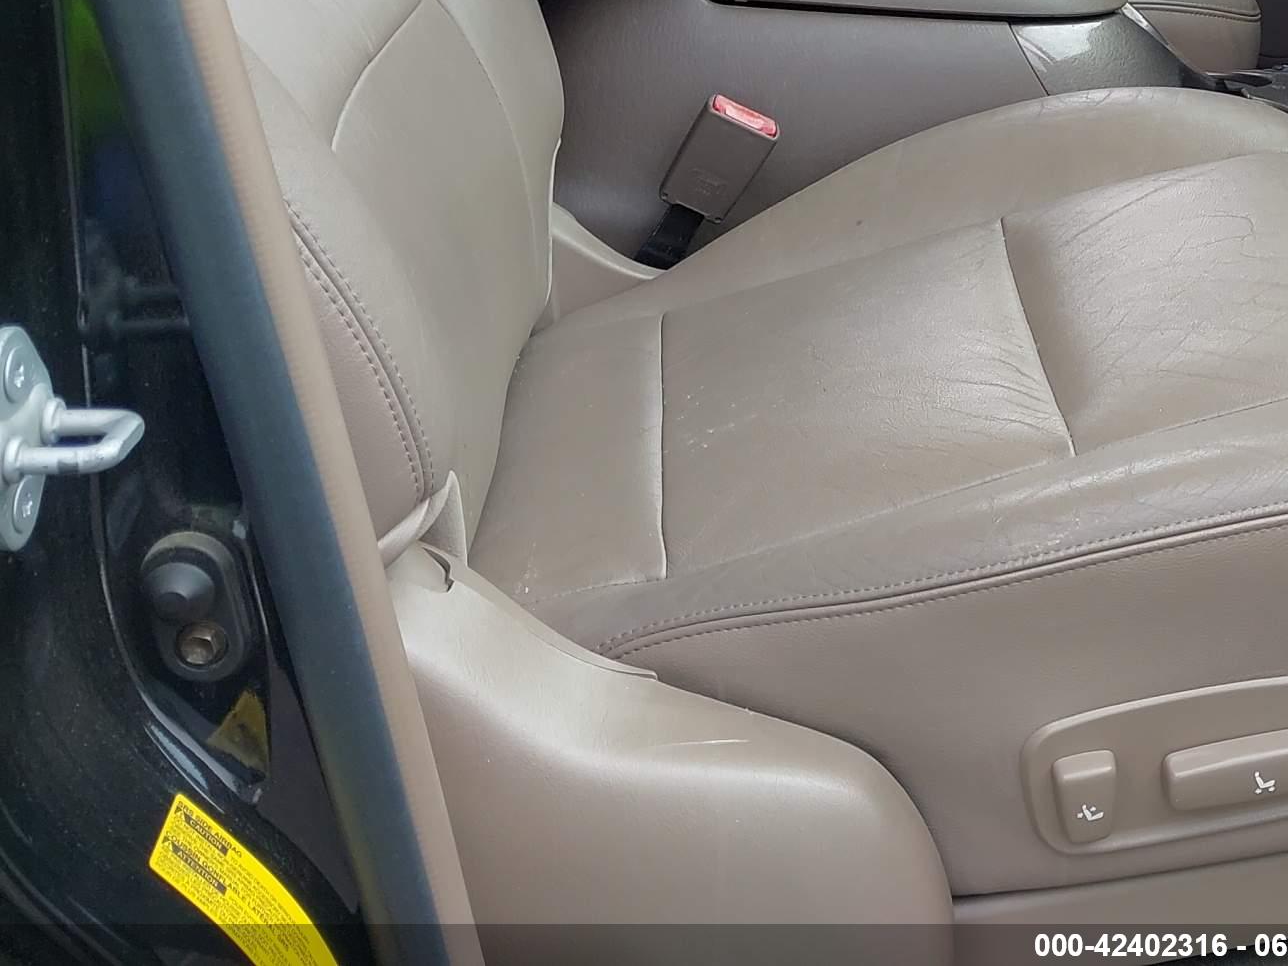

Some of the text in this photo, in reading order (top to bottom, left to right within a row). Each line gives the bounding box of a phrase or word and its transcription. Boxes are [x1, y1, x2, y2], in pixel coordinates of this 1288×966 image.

[189, 820, 222, 850] CAUTION
[195, 815, 213, 831] SIDE
[213, 832, 242, 858] AIRBAG
[177, 850, 219, 886] ATTENTION
